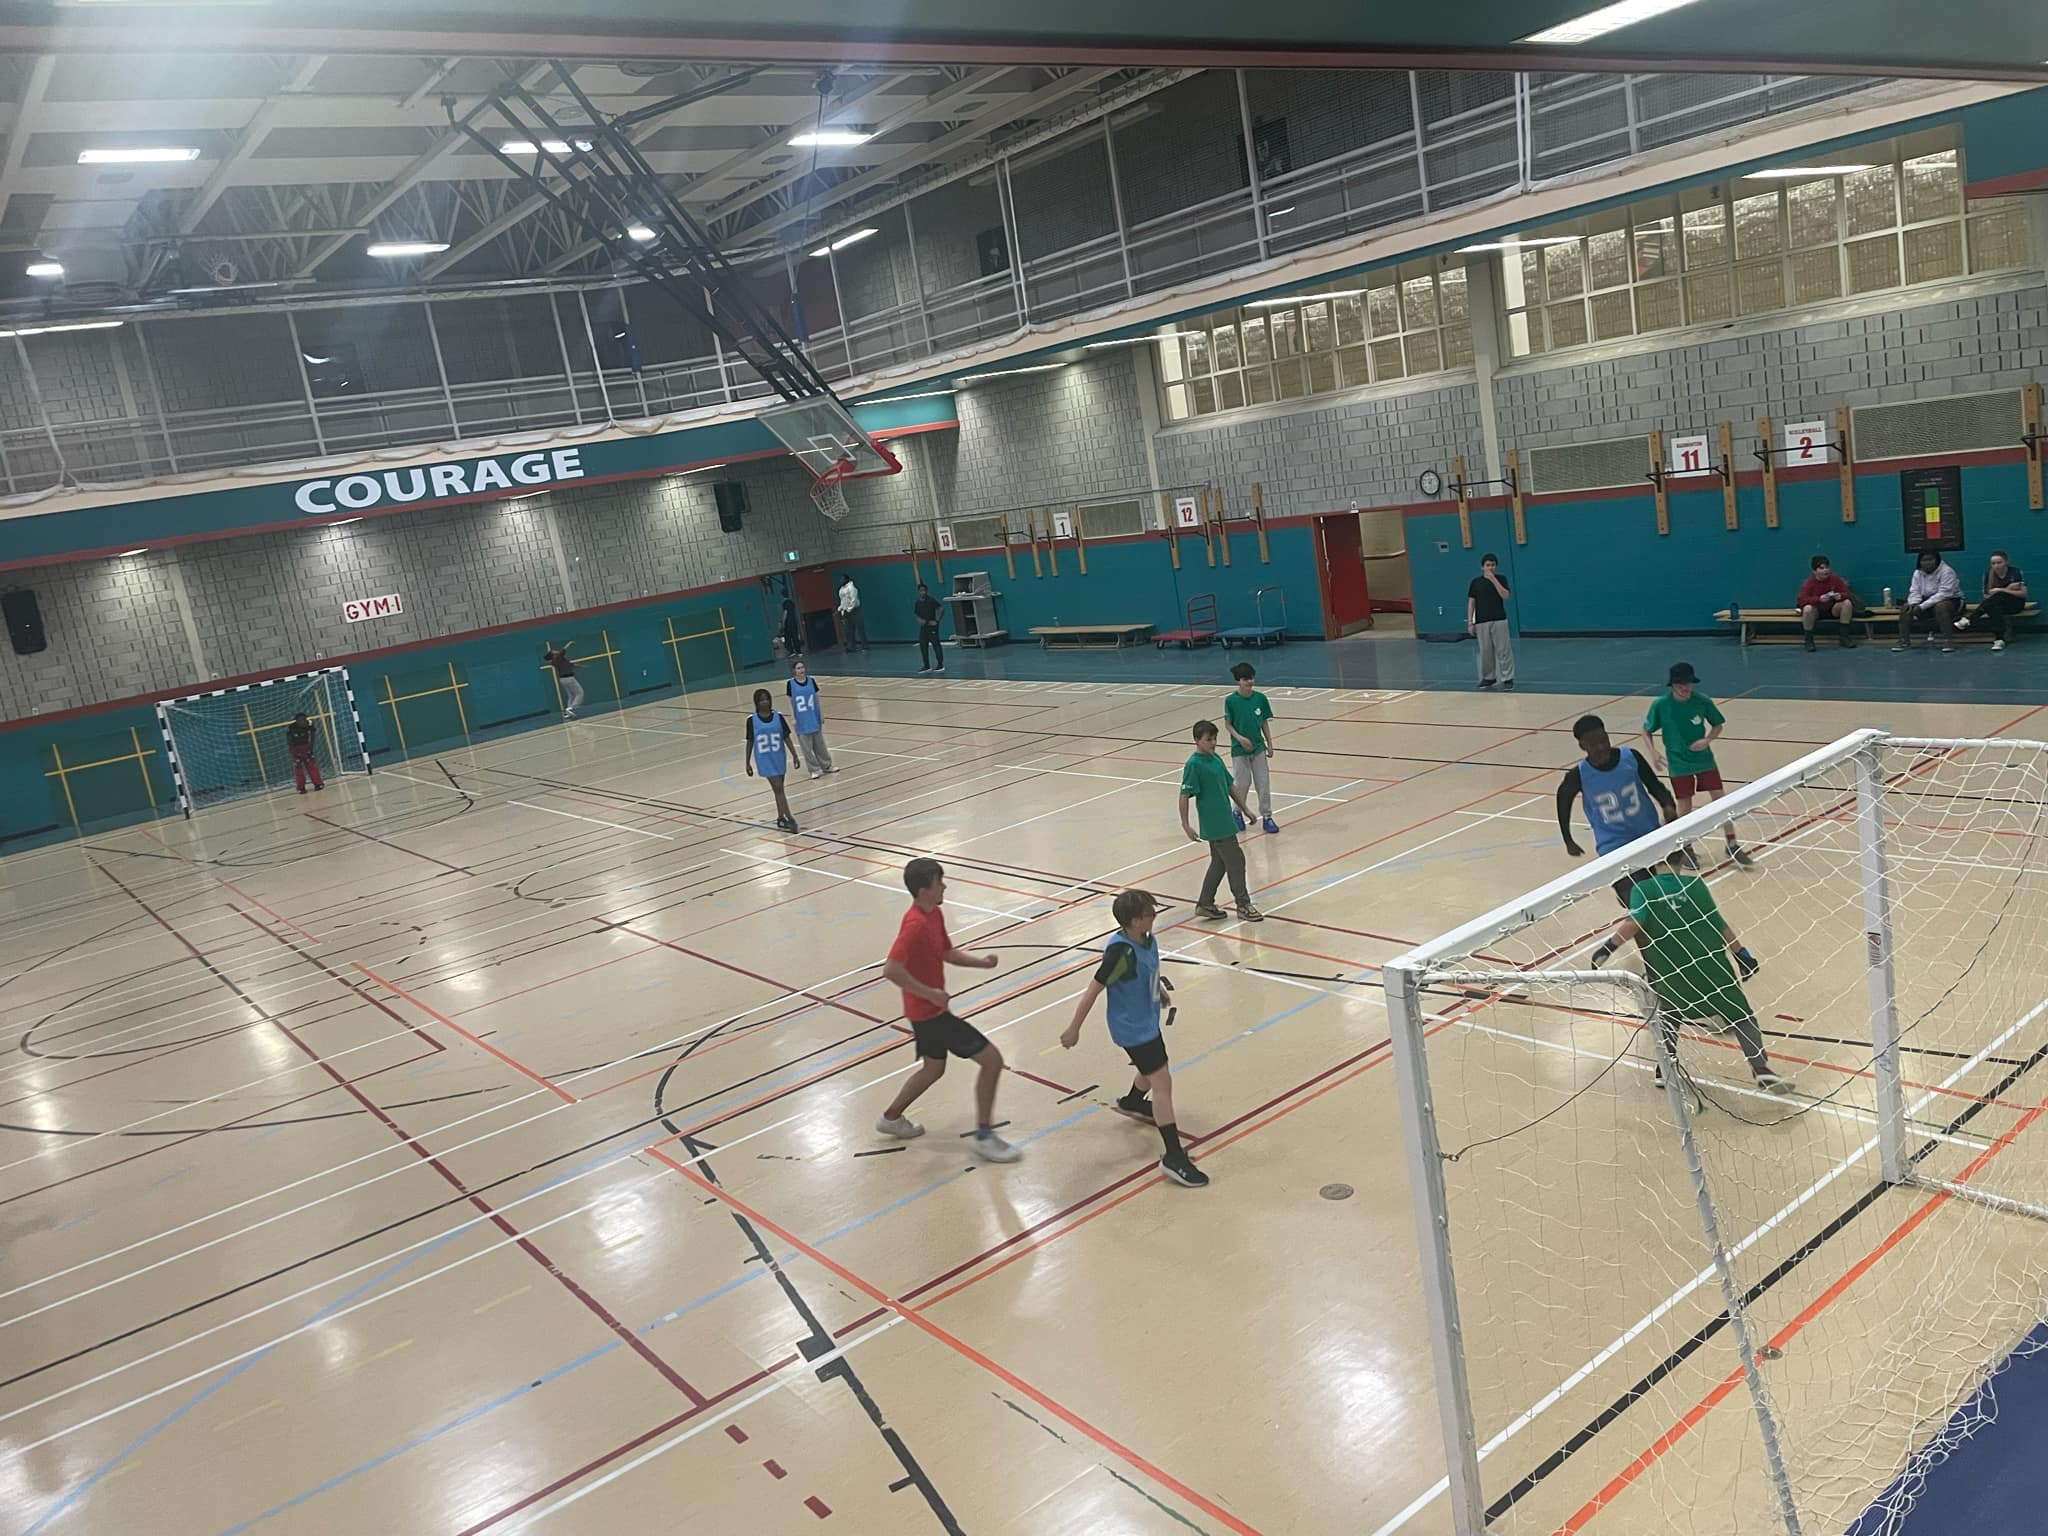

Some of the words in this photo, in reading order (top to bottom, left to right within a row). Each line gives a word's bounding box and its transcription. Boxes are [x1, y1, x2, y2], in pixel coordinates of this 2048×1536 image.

[1799, 436, 1813, 459] 2
[1681, 449, 1699, 471] 11
[294, 448, 585, 514] COURAGE
[1181, 507, 1193, 522] 12
[795, 694, 815, 713] 24
[757, 733, 781, 753] 25
[1594, 781, 1641, 824] 23
